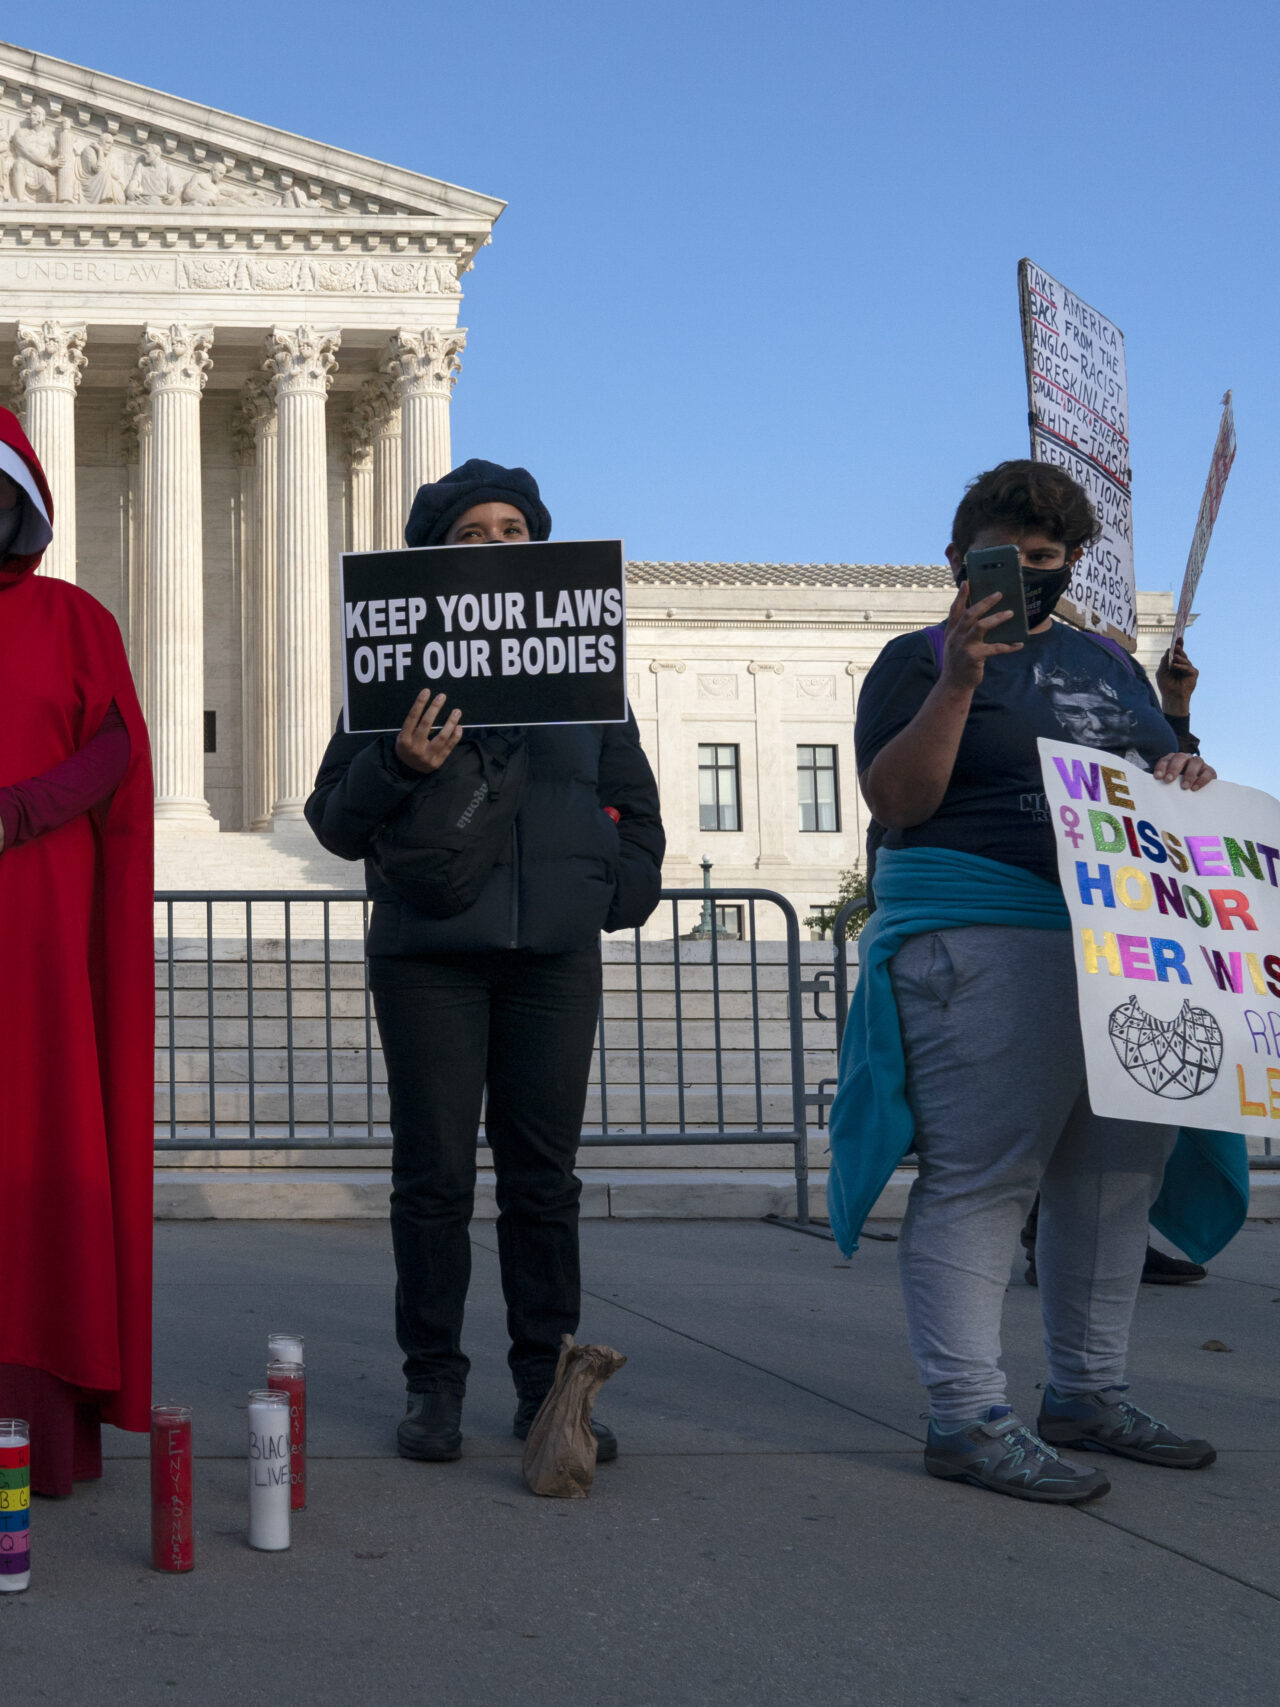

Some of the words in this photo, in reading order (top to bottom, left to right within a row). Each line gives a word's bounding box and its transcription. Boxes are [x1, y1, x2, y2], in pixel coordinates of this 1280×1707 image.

[15, 260, 102, 282] UNDER
[111, 263, 162, 282] LAW
[1027, 262, 1056, 305] TAKE
[1063, 291, 1117, 351] AMERICA
[1029, 292, 1059, 331] BACK
[1065, 320, 1094, 359] FROM
[1099, 346, 1119, 375] THE
[1032, 349, 1126, 436] FORESKINLESS
[1032, 375, 1062, 406] SMALL
[1066, 397, 1089, 428] DICK
[1092, 417, 1129, 459] ENERGY
[1039, 440, 1130, 519] REPARATIONS
[1096, 501, 1130, 542] BLACK
[345, 597, 427, 639] KEEP
[436, 592, 527, 633] YOUR
[535, 588, 623, 629] LAWS
[353, 643, 412, 684] OFF
[423, 639, 492, 680] OUR
[501, 634, 616, 676] BODIES
[1051, 756, 1136, 811] WE
[1087, 808, 1280, 888] DISSENT
[1075, 861, 1258, 931] HONOR
[1081, 928, 1193, 985] HER
[168, 1429, 185, 1570] ENVIRONMENT
